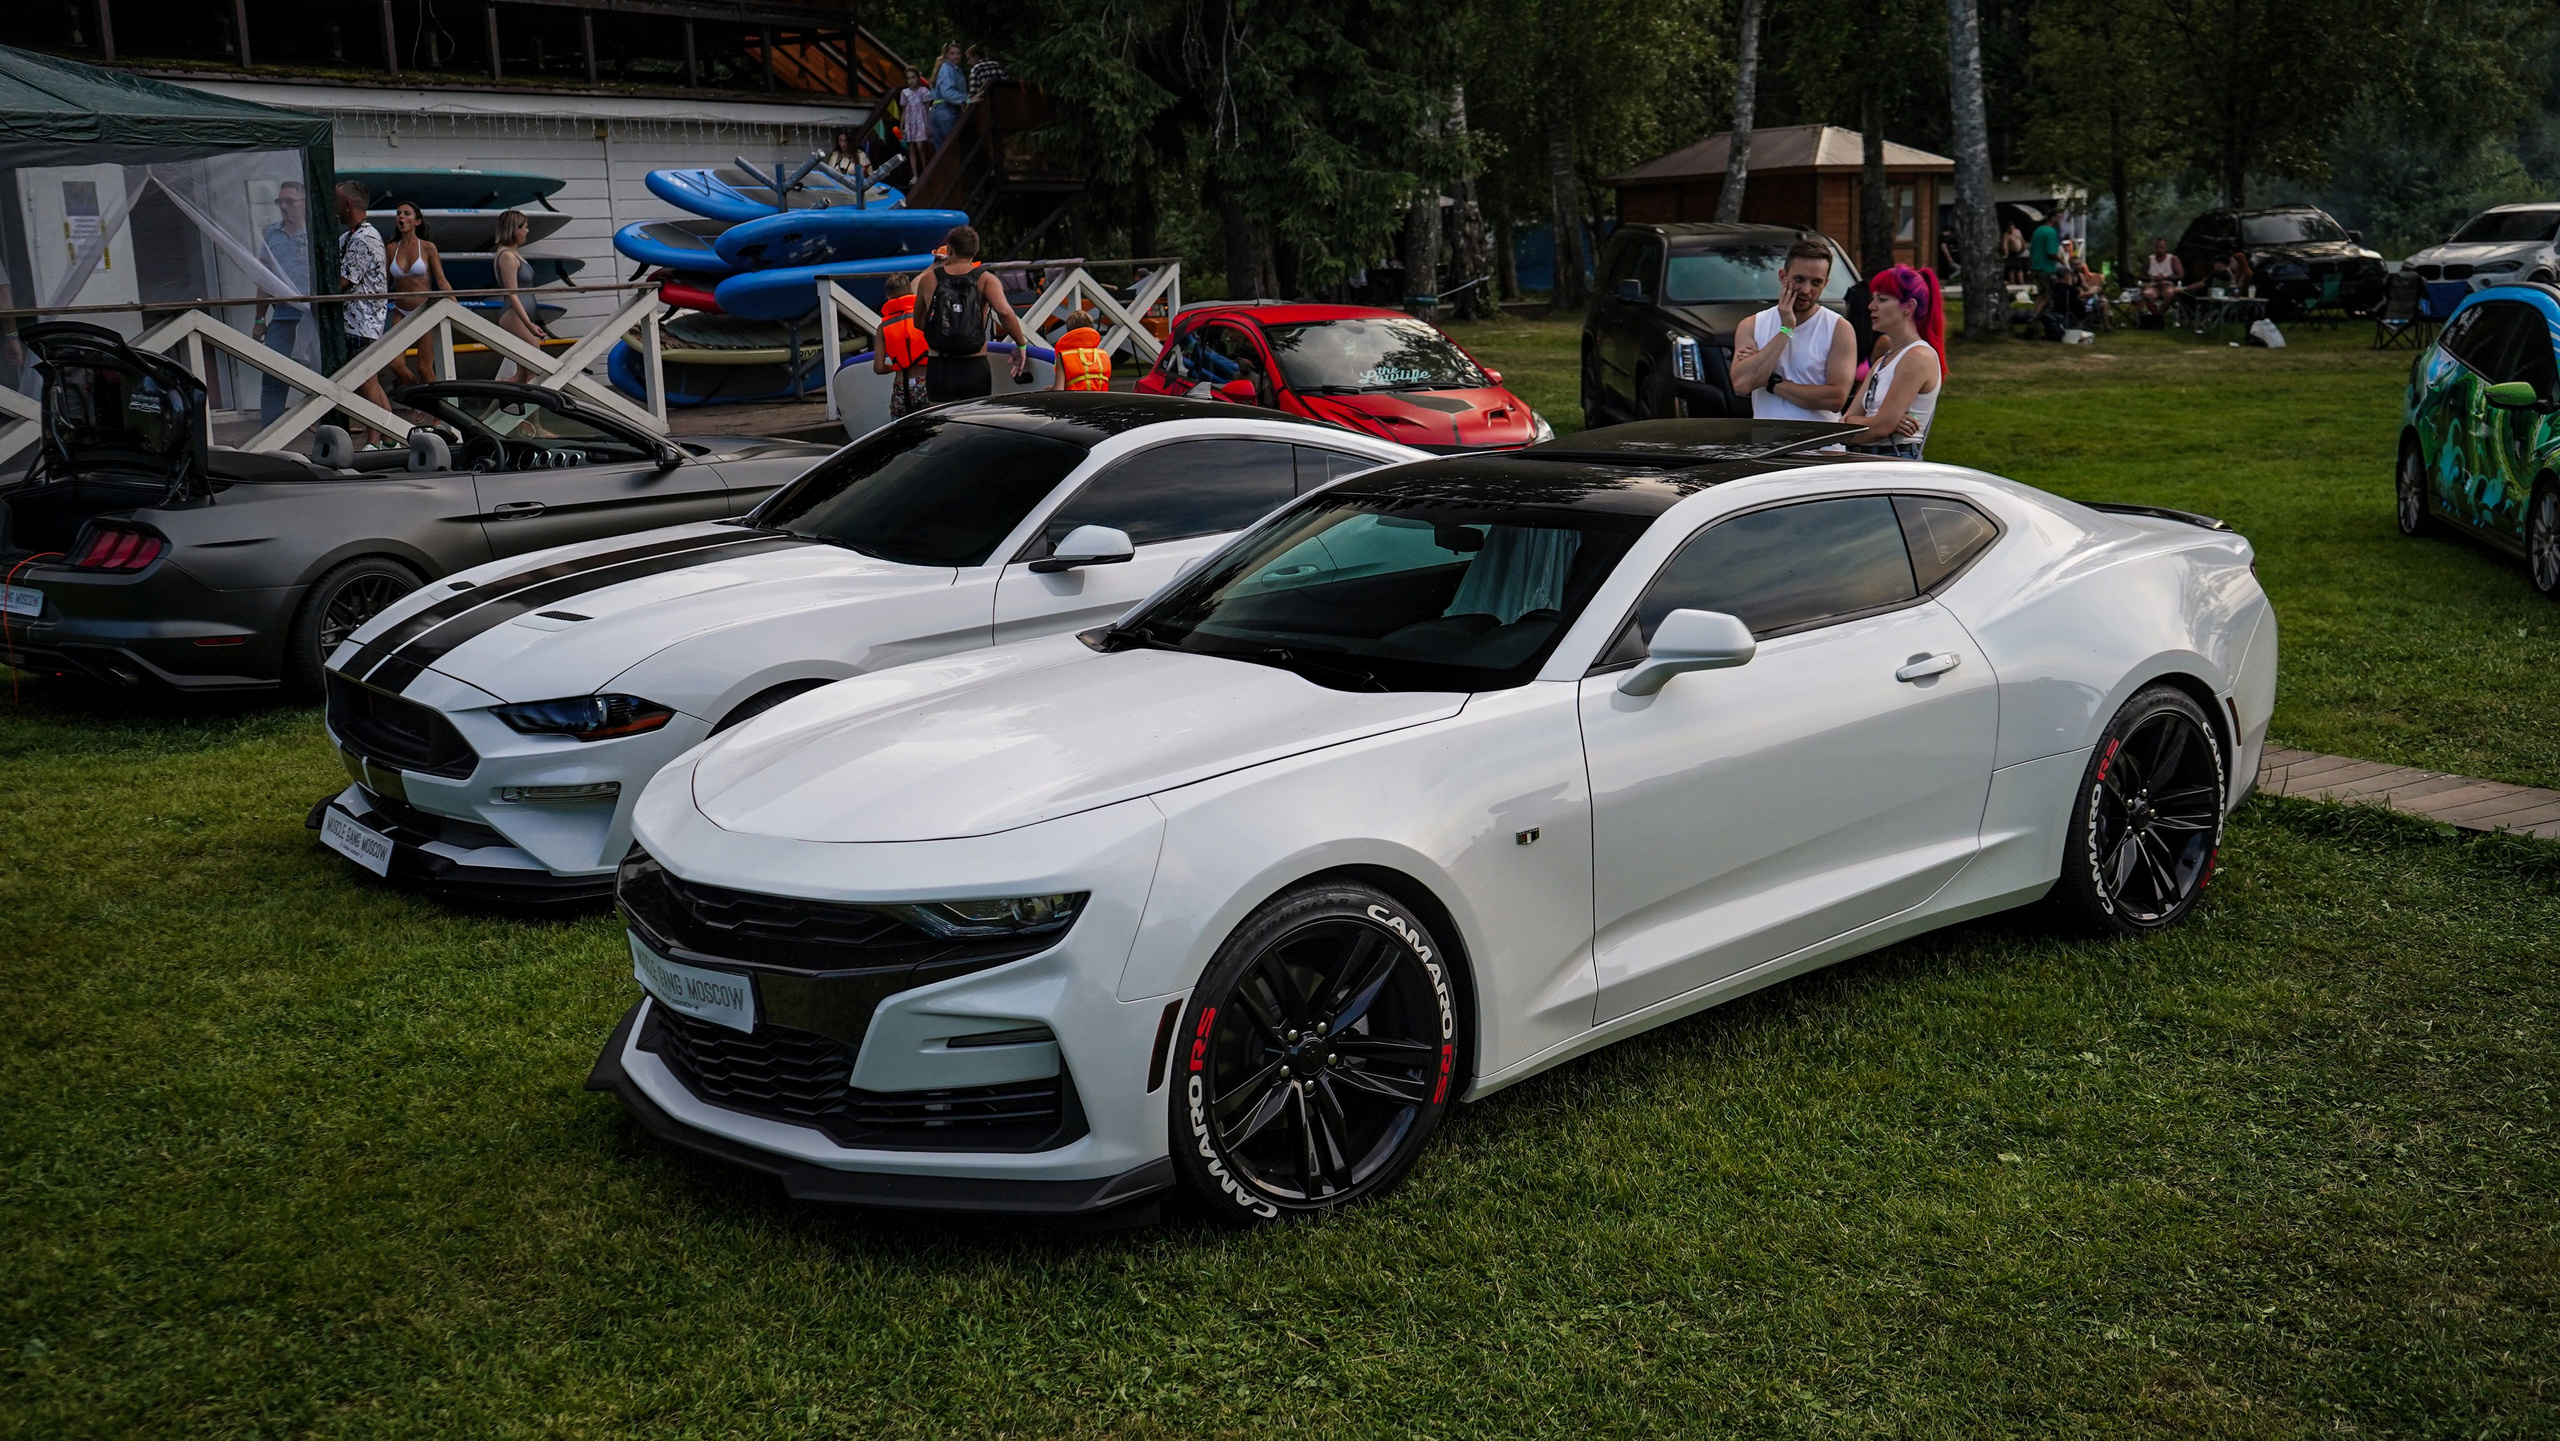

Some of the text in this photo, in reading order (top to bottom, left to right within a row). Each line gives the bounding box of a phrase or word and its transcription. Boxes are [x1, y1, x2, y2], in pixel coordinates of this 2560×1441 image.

[1358, 369, 1432, 385] Lowlife
[1377, 366, 1400, 375] the
[2088, 737, 2120, 915] CAMARO RS
[2202, 721, 2225, 847] CAMARO
[326, 816, 346, 839] MUSCLE
[346, 827, 362, 848] GANG
[361, 835, 389, 862] MOSCOW
[684, 976, 743, 1011] MOSCOW
[1366, 904, 1454, 1104] CAMARO RS
[1188, 1006, 1278, 1219] CAMARO RS
